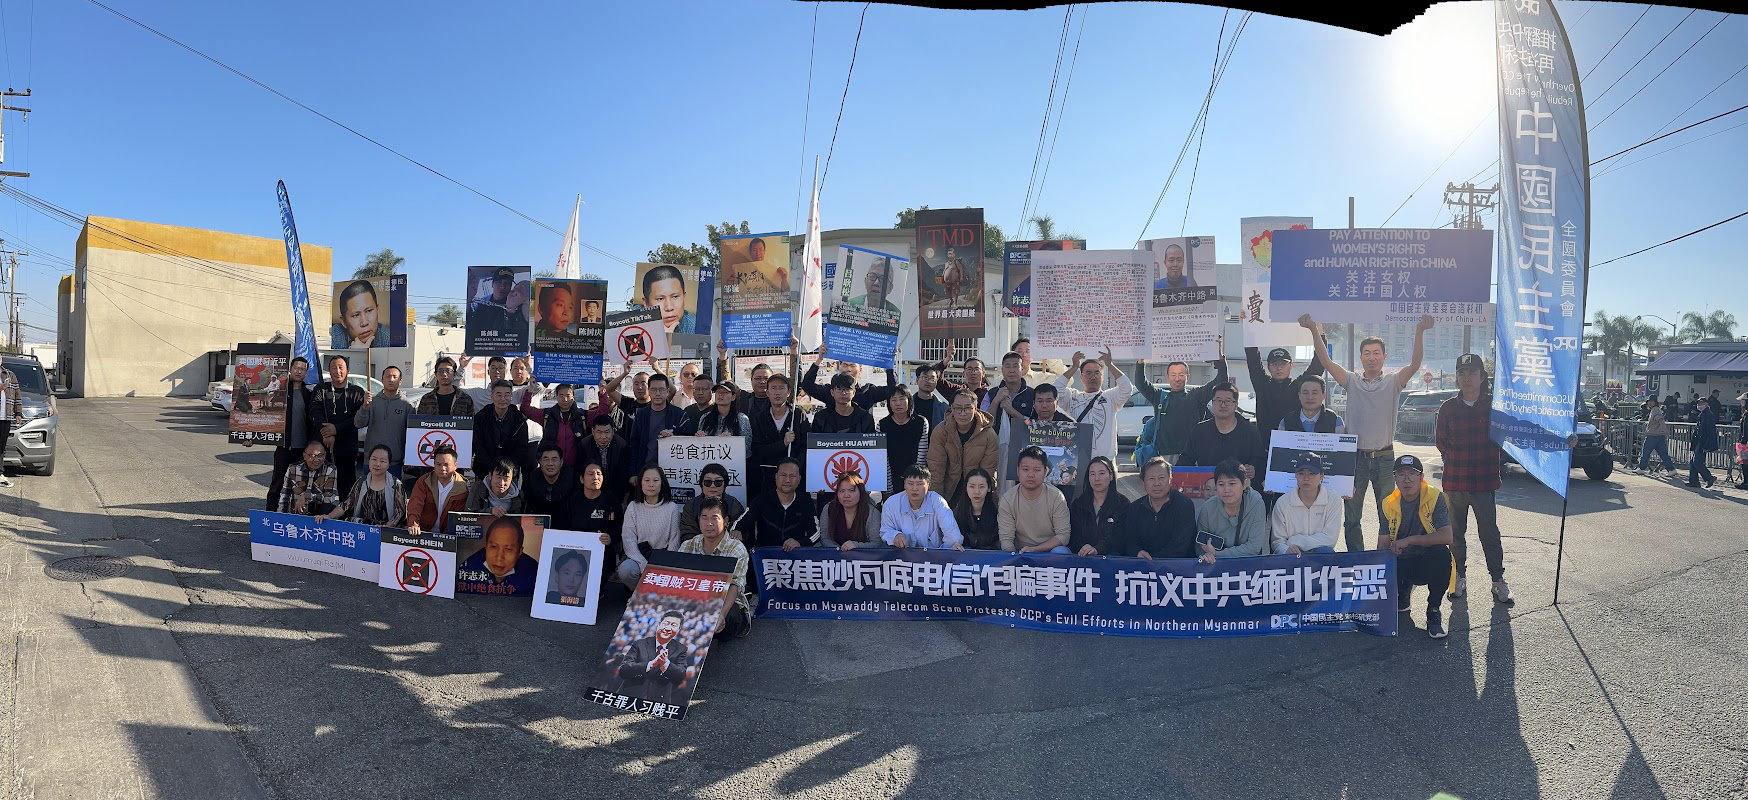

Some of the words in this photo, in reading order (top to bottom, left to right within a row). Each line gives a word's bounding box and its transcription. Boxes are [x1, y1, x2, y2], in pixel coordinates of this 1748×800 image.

[926, 228, 975, 249] TMD
[1329, 230, 1350, 241] PAY
[1353, 230, 1414, 241] ATTENTION
[1415, 230, 1430, 241] TO
[1332, 244, 1387, 254] WOMEN'S
[1388, 244, 1425, 254] RIGHTS
[1304, 256, 1326, 268] and
[1326, 257, 1367, 268] HUMAN
[1368, 257, 1409, 268] RIGHTS
[1410, 257, 1420, 268] in
[1420, 257, 1457, 269] CHINA
[1346, 270, 1411, 284] 关注女权
[1328, 284, 1426, 298] 关注中国人权
[1247, 290, 1264, 324] 賣
[609, 318, 630, 326] Boycott
[631, 314, 652, 322] TikTok
[230, 431, 283, 441] 千古罪人习包子
[670, 443, 732, 460] 绝食抗议
[262, 517, 270, 527] 北
[272, 522, 356, 548] 乌鲁木齐中路
[358, 530, 366, 540] 南
[393, 535, 418, 546] Boycott
[420, 540, 444, 548] SHEIN
[458, 570, 488, 581] 许志永
[642, 572, 726, 593] 卖国贼习皇帝
[762, 558, 1100, 602] 聚焦妙瓦底电信诈骗事件
[1116, 564, 1388, 607] 抗议中共缅北作恶
[457, 582, 516, 595] 狱中绝食抗争
[767, 599, 800, 611] Focus
[805, 602, 818, 611] on
[822, 600, 880, 612] Myawaddy
[884, 601, 928, 612] Telecom
[932, 604, 962, 613] Scam
[966, 606, 1016, 618] Protests
[1020, 608, 1052, 623] CCP's
[1056, 613, 1077, 626] Evil
[1082, 614, 1125, 629] Efforts
[1130, 618, 1140, 630] in
[1145, 619, 1199, 631] Northern
[1204, 619, 1260, 632] Myanmar
[1270, 614, 1298, 629] DPC
[591, 689, 680, 719] 千古罪人习贱平
